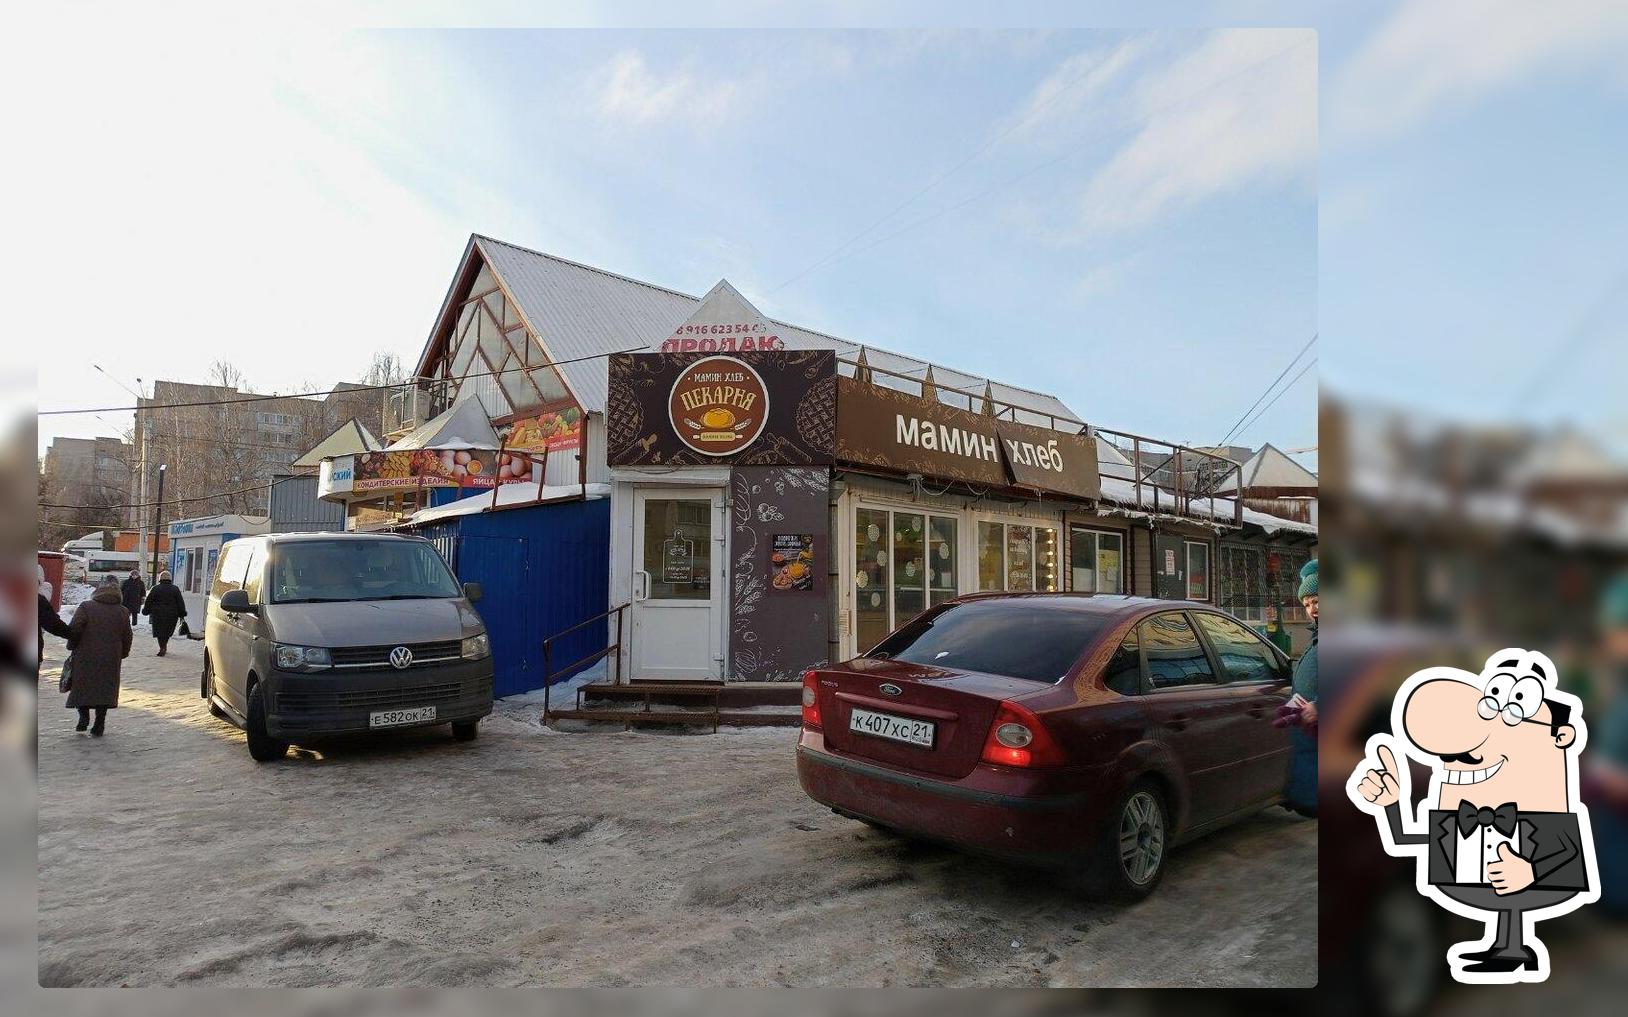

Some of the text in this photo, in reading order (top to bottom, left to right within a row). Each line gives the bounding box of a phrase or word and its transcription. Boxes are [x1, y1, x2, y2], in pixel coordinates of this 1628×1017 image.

[694, 373, 744, 382] МАМИН ХЛЕБ
[680, 385, 757, 411] ПЕКАРНЯ
[1006, 439, 1064, 473] хлеб
[473, 477, 495, 486] ЯЙЦА
